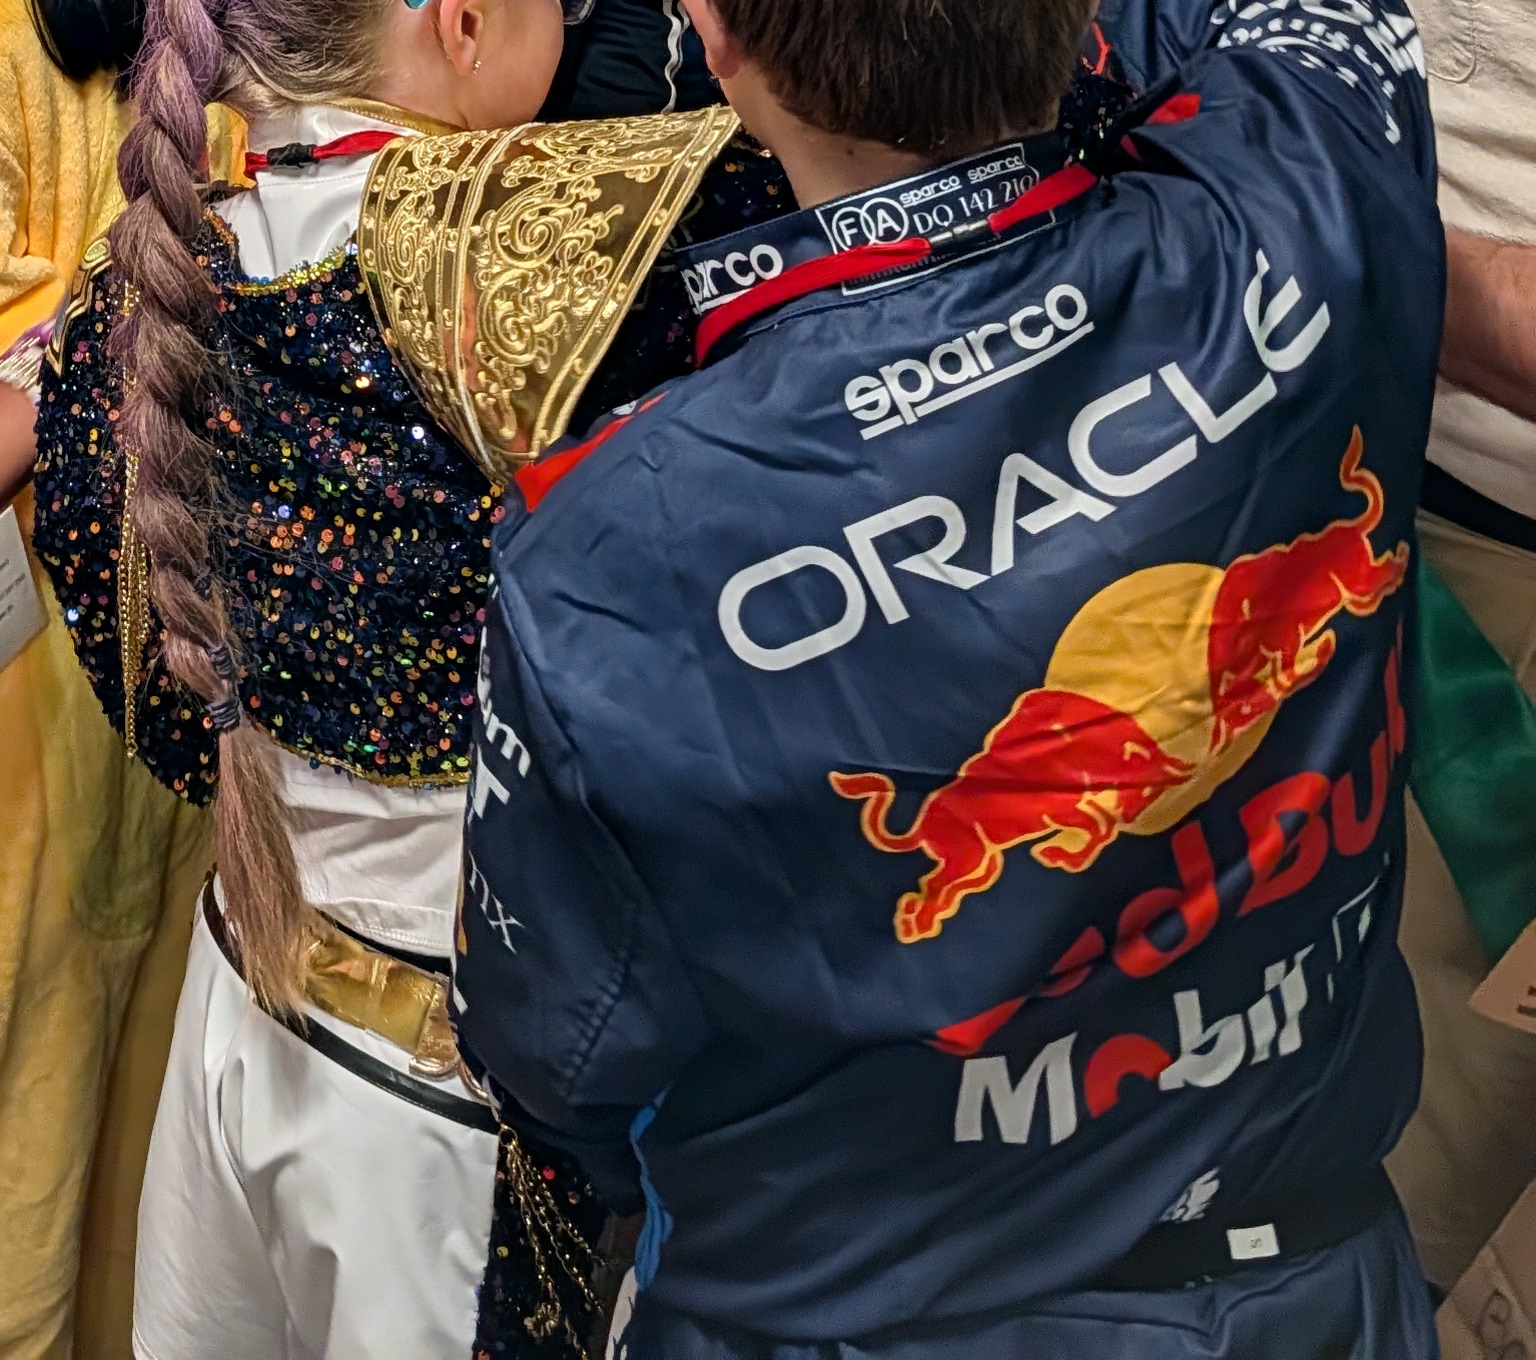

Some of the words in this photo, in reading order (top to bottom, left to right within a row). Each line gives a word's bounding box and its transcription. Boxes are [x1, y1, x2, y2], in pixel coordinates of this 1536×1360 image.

[899, 175, 962, 209] sparco
[958, 188, 999, 217] 142
[844, 284, 1095, 440] sparco
[718, 249, 1331, 671] ORACLE
